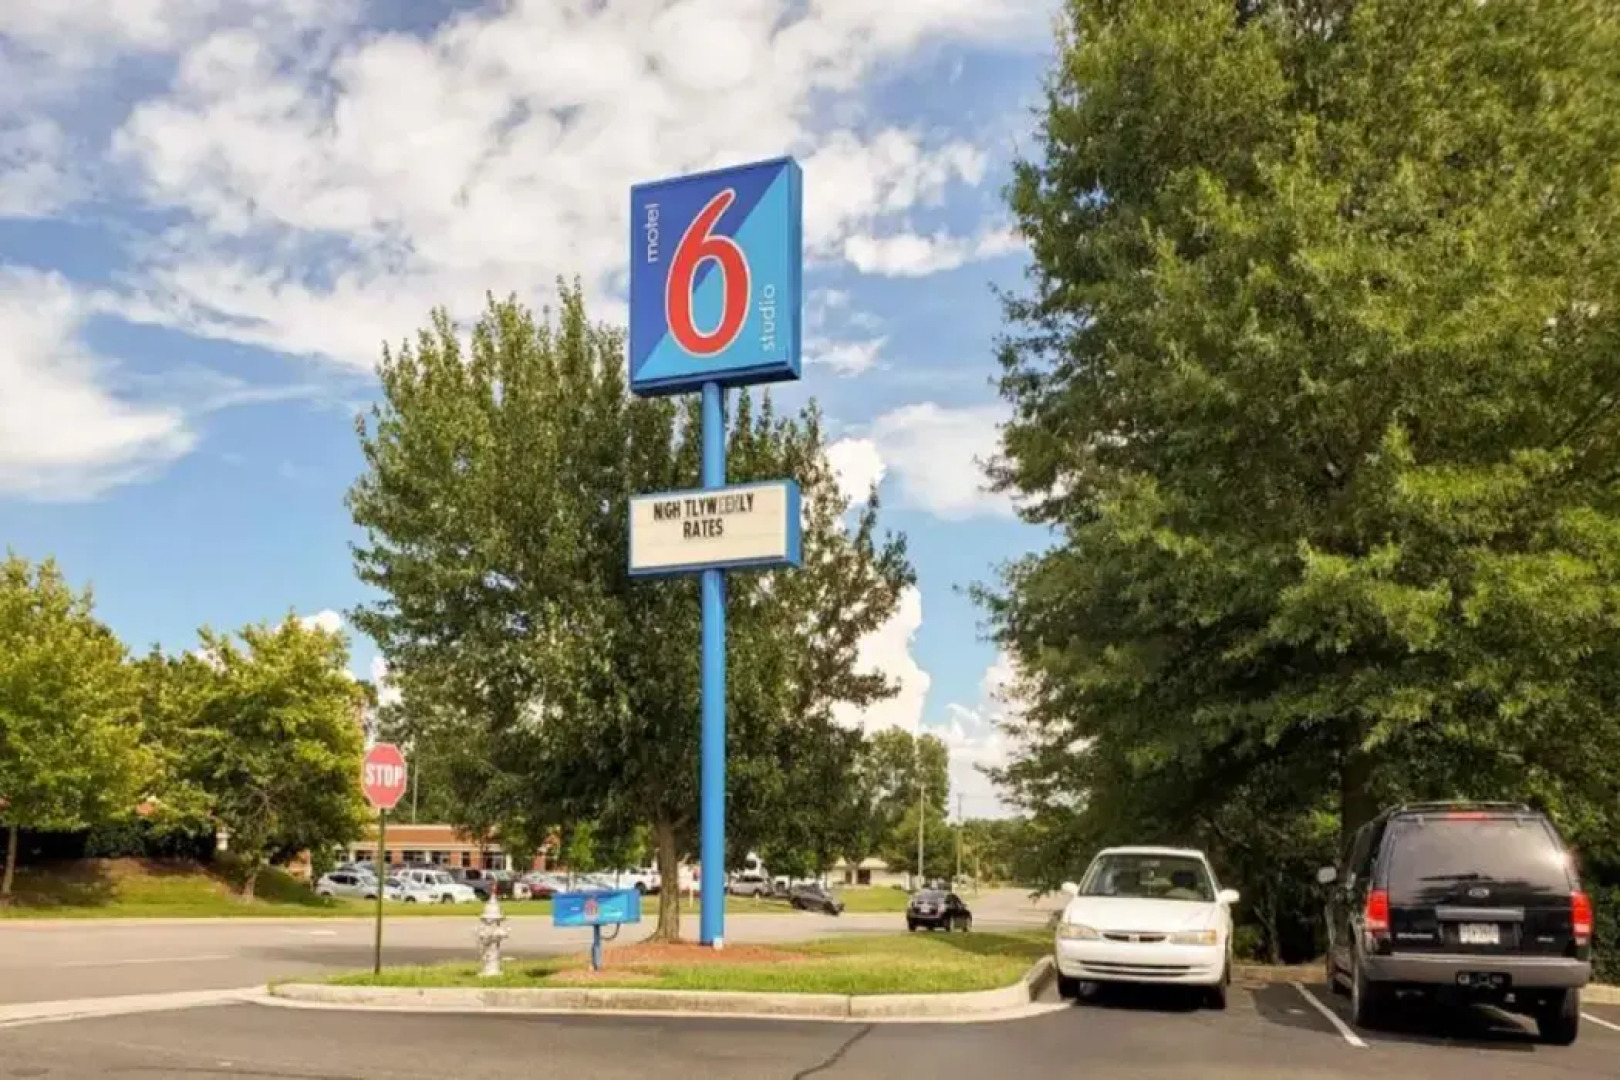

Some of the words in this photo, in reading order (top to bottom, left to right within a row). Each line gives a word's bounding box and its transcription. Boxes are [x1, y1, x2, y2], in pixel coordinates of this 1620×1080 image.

[644, 203, 660, 264] motel
[665, 187, 751, 358] 6
[758, 284, 775, 352] studio
[683, 517, 723, 538] RATES
[364, 762, 404, 788] STOP
